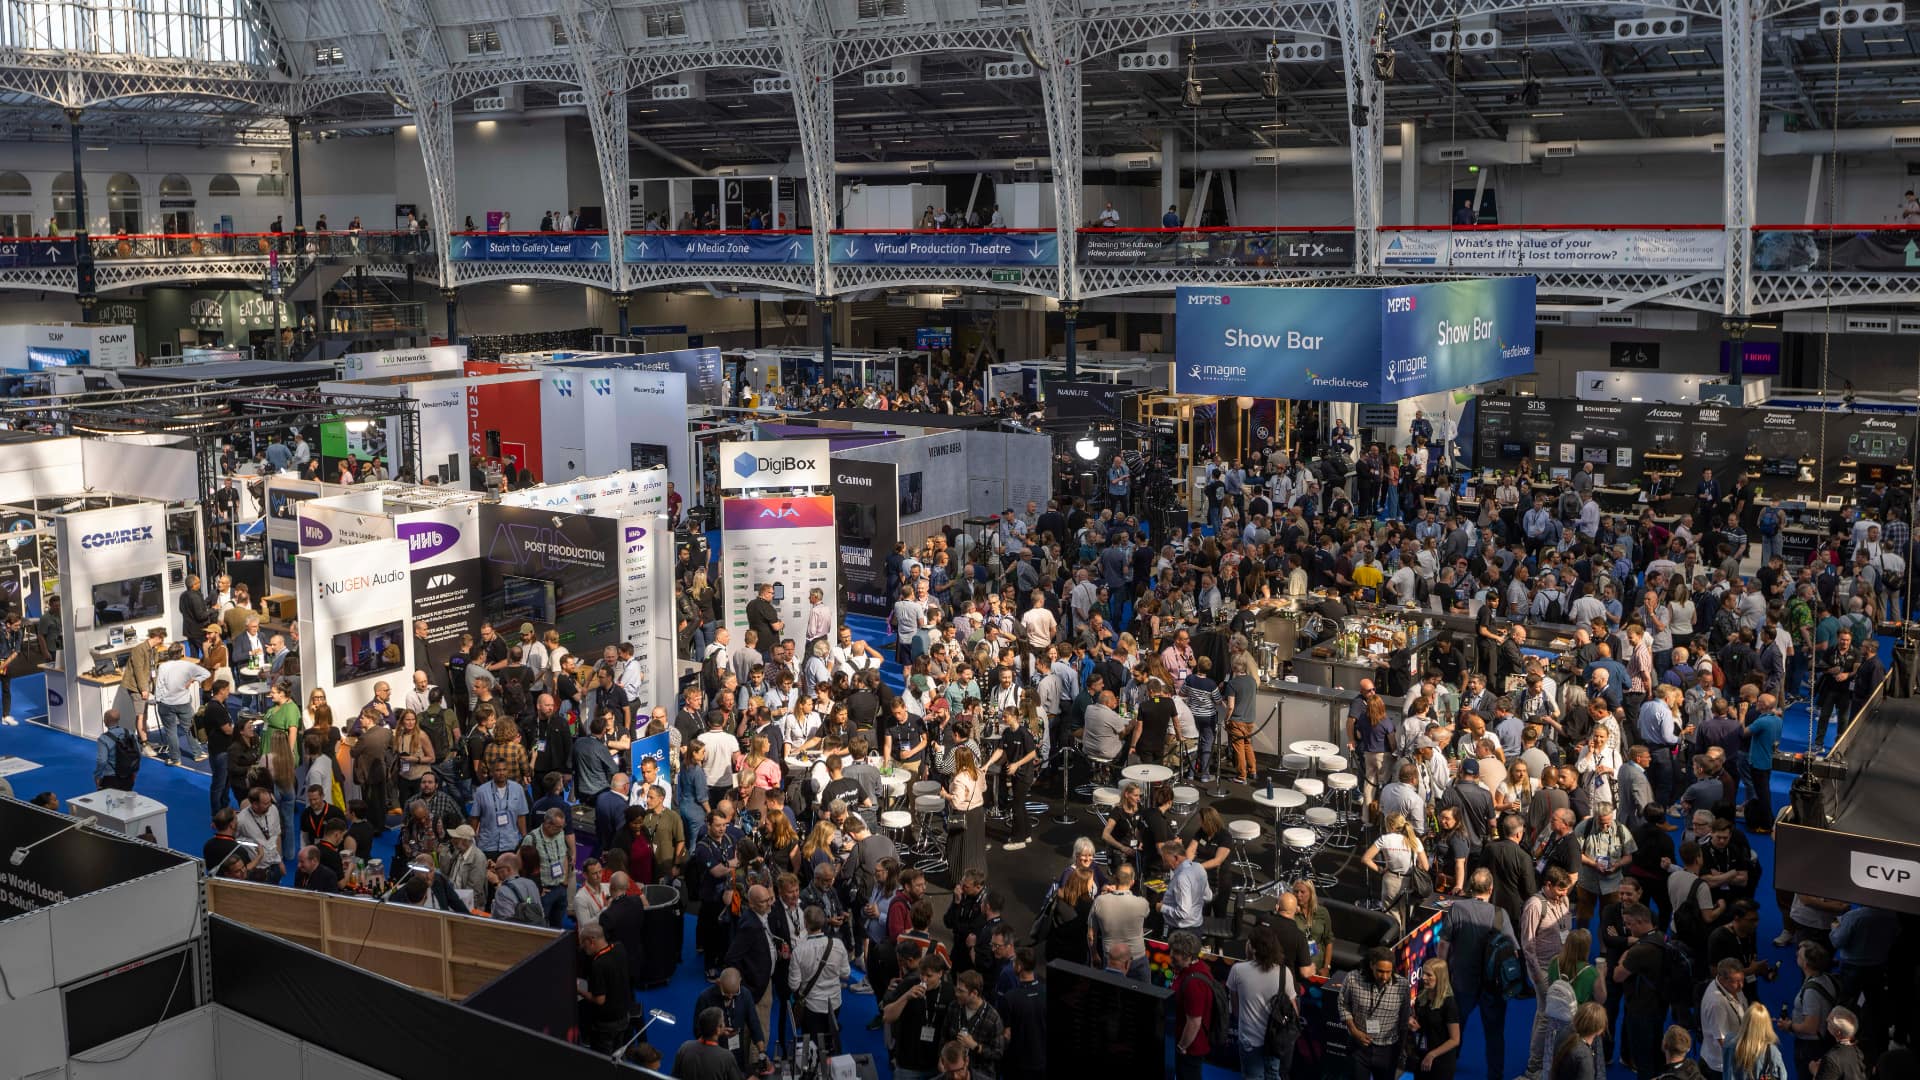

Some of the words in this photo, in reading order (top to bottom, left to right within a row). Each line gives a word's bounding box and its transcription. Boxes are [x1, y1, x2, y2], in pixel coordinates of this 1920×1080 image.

[0, 245, 17, 254] GY
[489, 243, 510, 253] Stairs
[512, 244, 520, 253] to
[522, 243, 548, 255] Gallery
[550, 243, 571, 253] Level
[686, 243, 696, 253] AI
[697, 243, 725, 253] Media
[727, 243, 750, 253] Zone
[874, 242, 908, 254] Virtual
[910, 242, 966, 254] Production
[969, 243, 1011, 254] Theatre
[1289, 243, 1325, 257] LTX
[1454, 238, 1493, 248] What's
[1496, 239, 1514, 248] the
[1516, 238, 1548, 249] value
[1551, 239, 1564, 248] of
[1565, 239, 1592, 250] your
[1452, 251, 1496, 260] content
[1497, 251, 1506, 260] if
[1528, 251, 1551, 260] lost
[1554, 250, 1618, 261] tomorrow?
[1188, 295, 1222, 305] MPTS
[1387, 296, 1411, 313] MPTS
[1437, 318, 1471, 347] Show
[1473, 316, 1494, 341] Bar
[1224, 328, 1281, 348] Show
[1287, 330, 1324, 350] Bar
[396, 354, 427, 363] Networks
[1397, 355, 1428, 375] imagine
[1203, 364, 1247, 378] imagine
[1313, 377, 1369, 388] medialease
[1057, 389, 1089, 397] NANLITE
[758, 456, 816, 475] DigiBox
[837, 474, 873, 487] Canon
[759, 507, 800, 519] AJA
[81, 525, 153, 549] COMREX
[524, 541, 547, 553] POST
[548, 543, 606, 562] PRODUCTION
[325, 575, 370, 596] NUGEN
[372, 569, 405, 586] Audio
[1866, 865, 1911, 883] CVP
[8, 872, 37, 895] World
